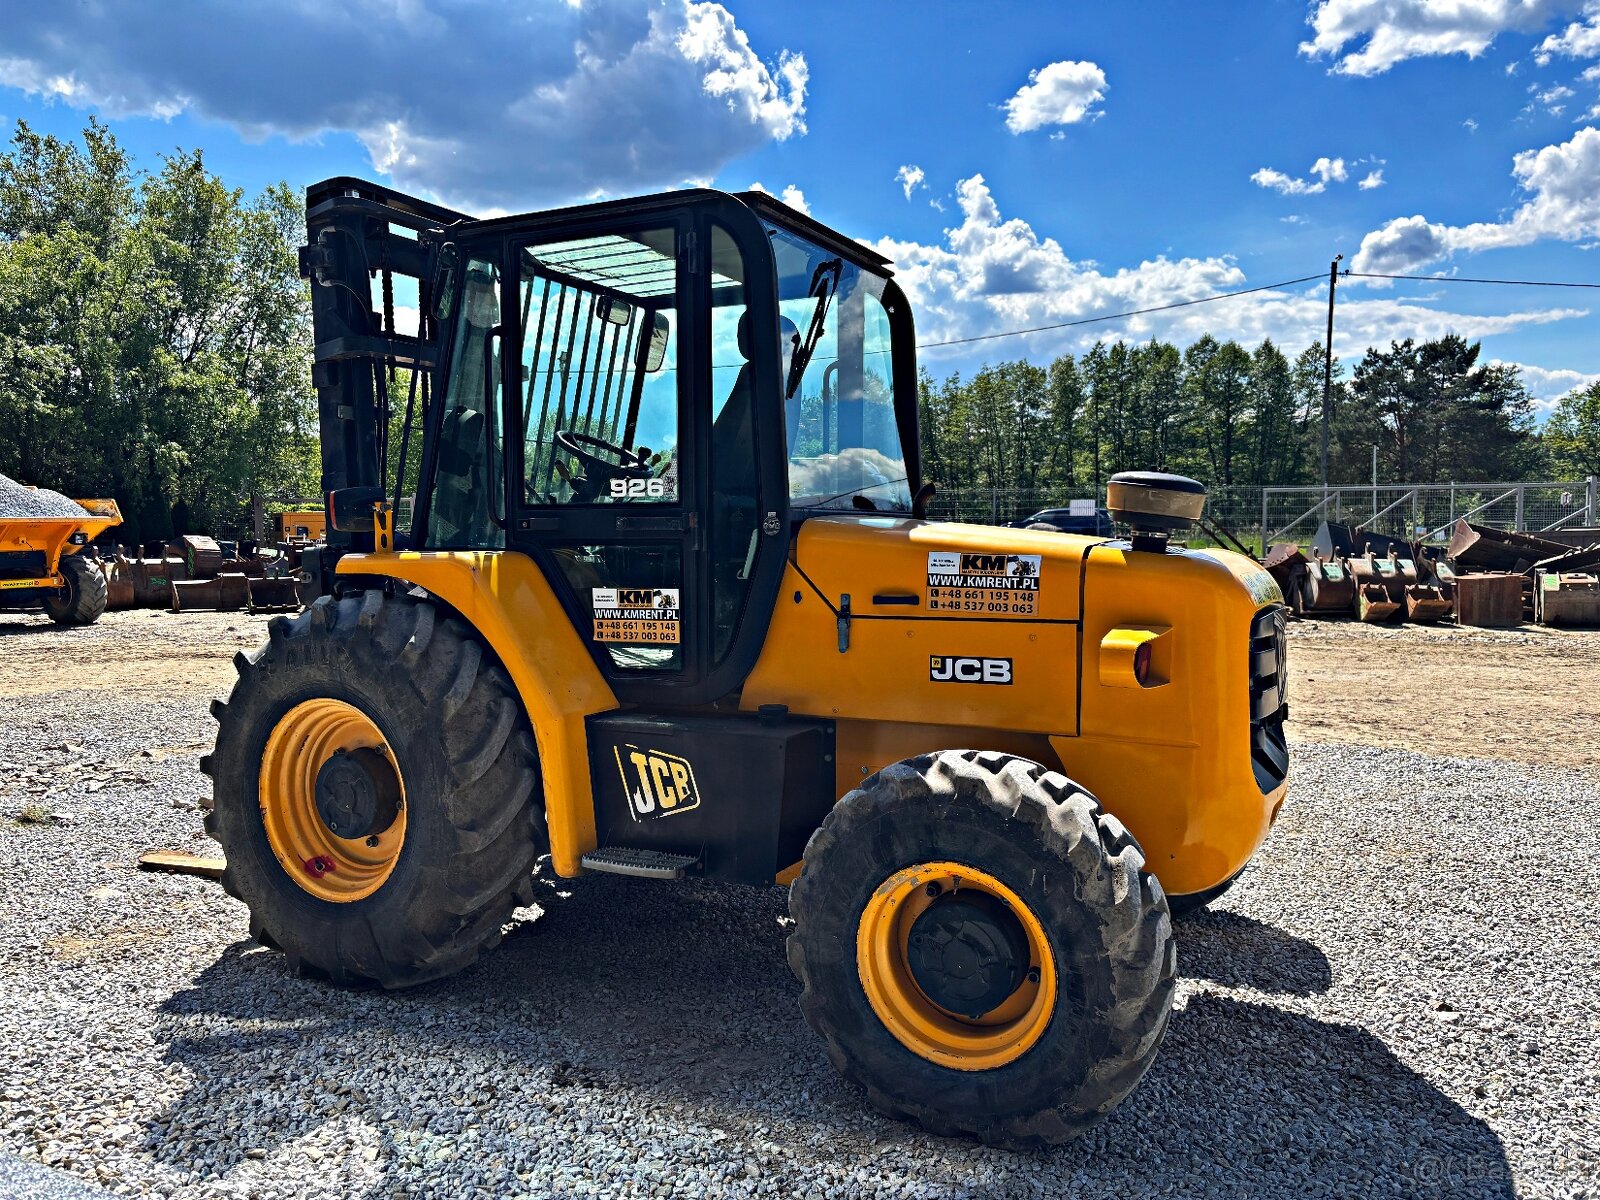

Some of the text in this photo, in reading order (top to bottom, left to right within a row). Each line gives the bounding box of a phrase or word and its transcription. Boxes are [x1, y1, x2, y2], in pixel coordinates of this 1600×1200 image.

[610, 478, 664, 498] 926
[962, 555, 1006, 570] KM
[928, 574, 1038, 590] WWW.KMRENT.PL
[619, 591, 652, 604] KM
[940, 589, 1034, 602] +48 661 195 148
[940, 600, 1033, 613] +48 537 003 063
[594, 609, 679, 620] WWW.KMRENT.PL
[604, 621, 676, 631] +48 661 195 148
[604, 631, 621, 639] +48
[641, 632, 658, 640] 003
[660, 632, 676, 640] 063
[931, 658, 1012, 683] JCB
[629, 751, 691, 814] JCB
